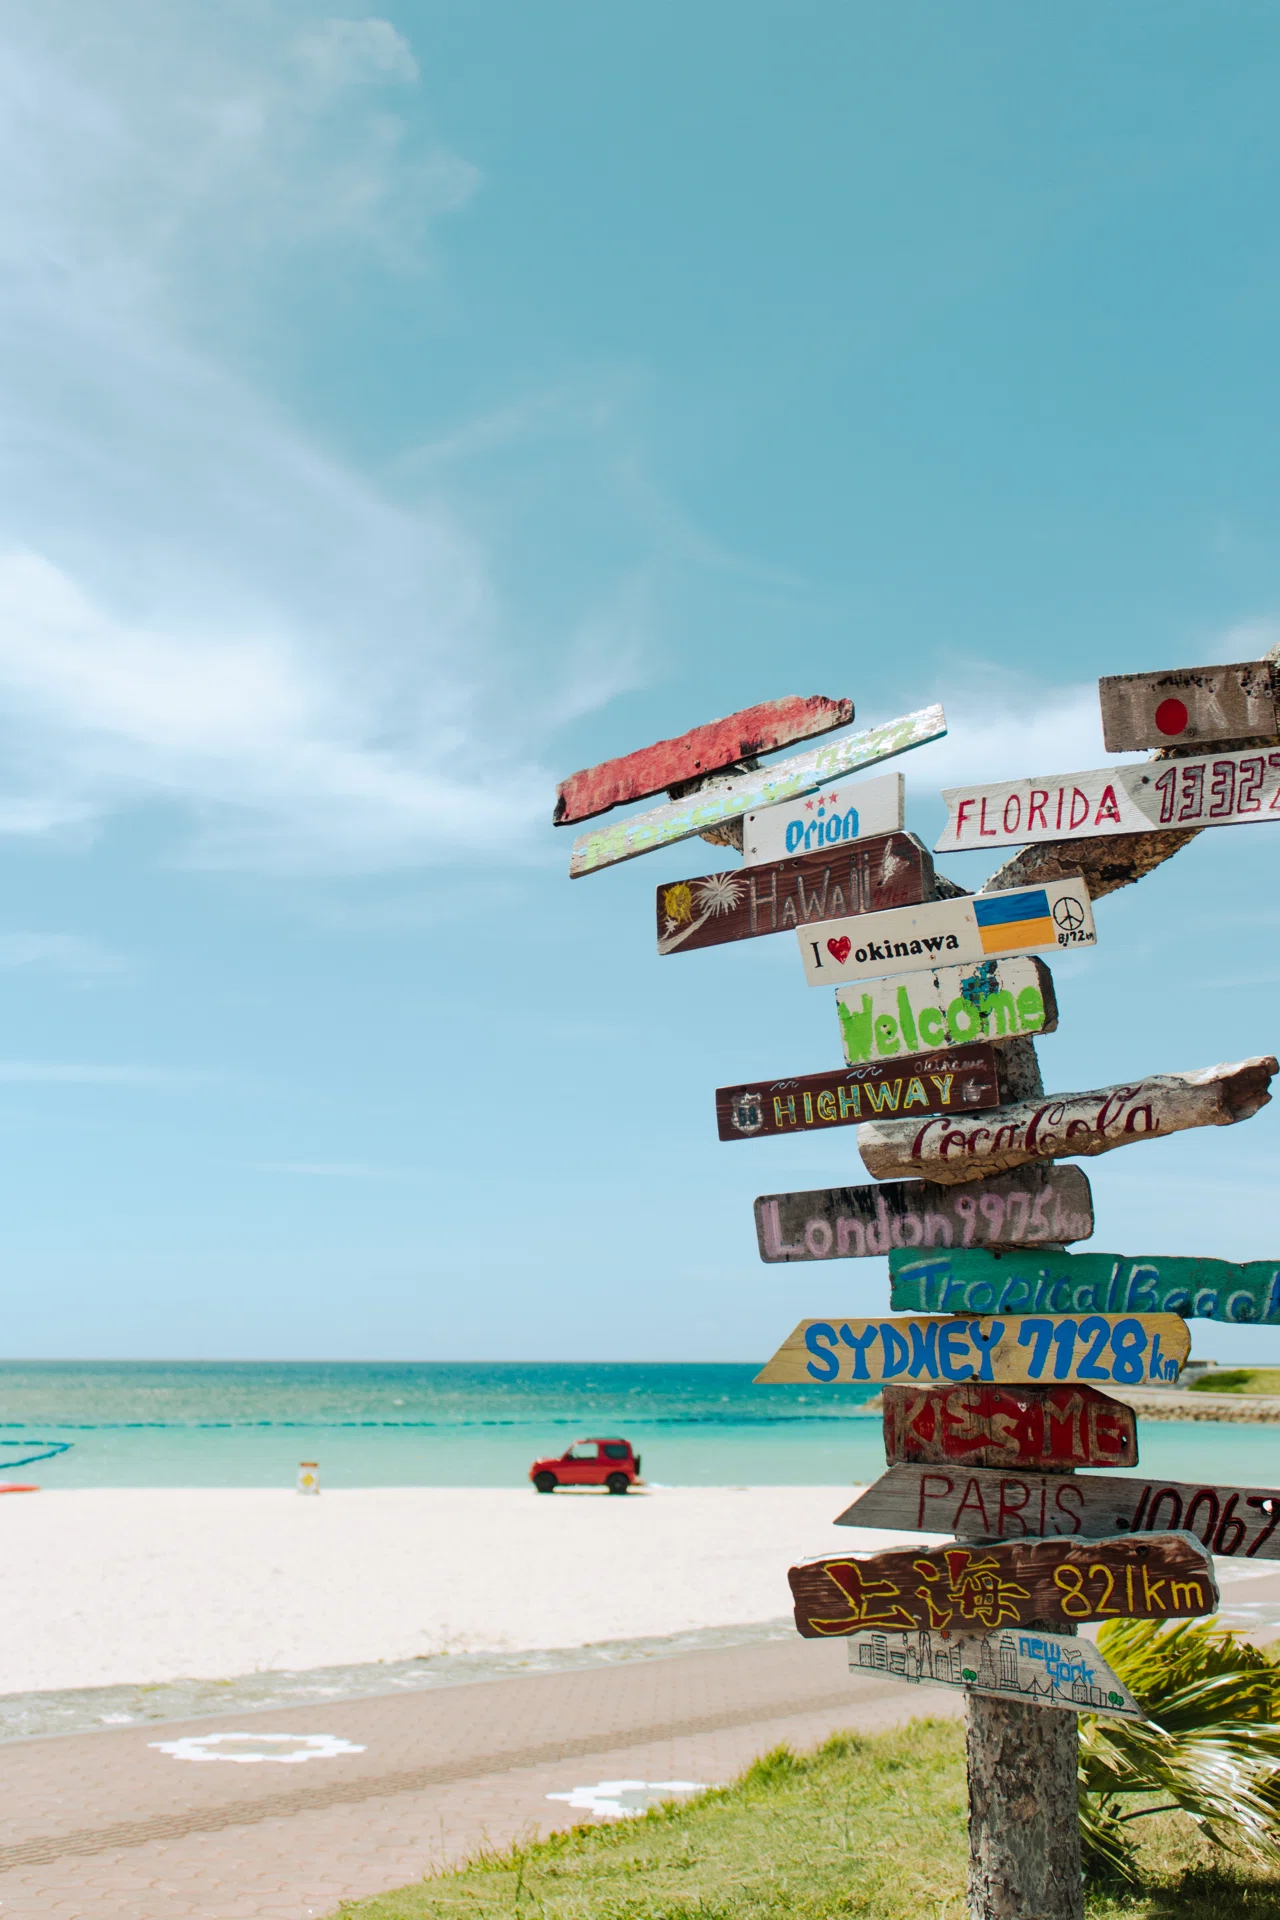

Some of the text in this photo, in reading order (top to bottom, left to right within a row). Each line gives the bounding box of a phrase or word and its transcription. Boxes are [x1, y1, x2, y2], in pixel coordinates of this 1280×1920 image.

[956, 784, 1121, 840] FLORIDA
[810, 934, 960, 968] I okinawa
[838, 985, 1046, 1063] Welcome
[773, 1074, 954, 1127] HIGHWAY
[760, 1196, 953, 1259] London
[804, 1320, 1005, 1382] SYDNEY
[1042, 1391, 1133, 1462] ME
[808, 1550, 1031, 1635] 上海
[1018, 1636, 1061, 1661] new
[1045, 1660, 1095, 1688] york
